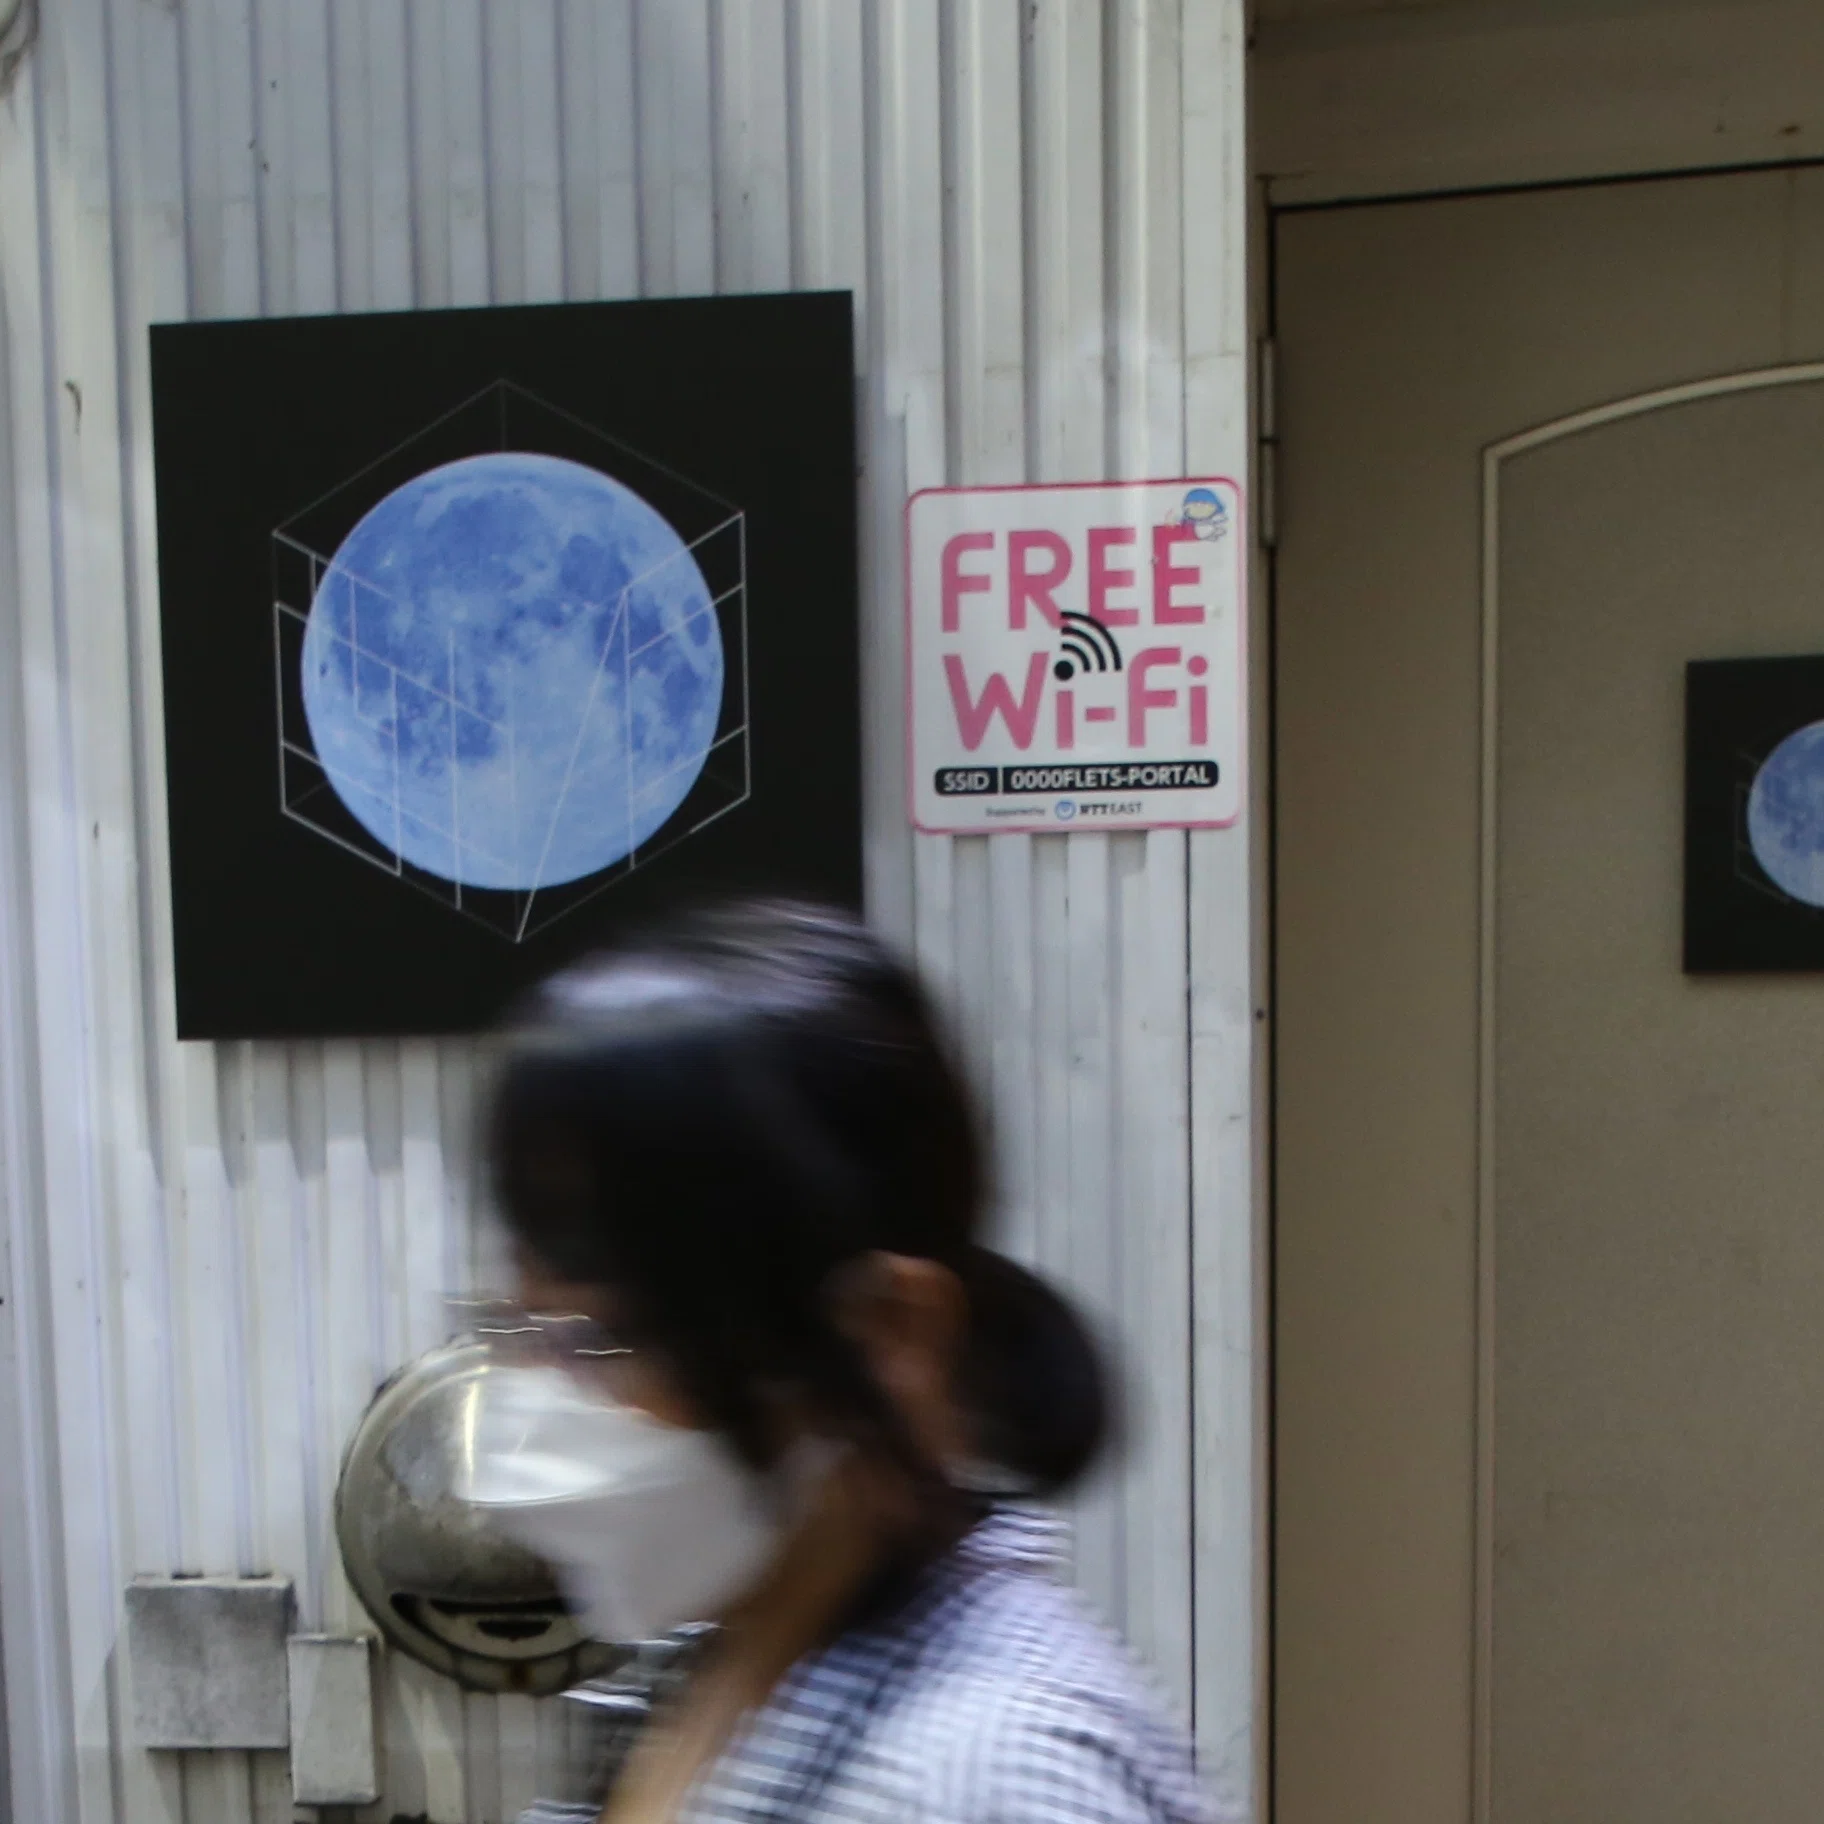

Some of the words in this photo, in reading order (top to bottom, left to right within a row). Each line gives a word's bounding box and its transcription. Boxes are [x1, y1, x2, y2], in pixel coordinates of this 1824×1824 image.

[941, 525, 1206, 633] FREE
[942, 646, 1208, 752] Wi-Fi
[943, 771, 989, 792] SSID
[1010, 765, 1210, 790] 0000FLETS-PORTAL
[1110, 801, 1142, 815] EAST
